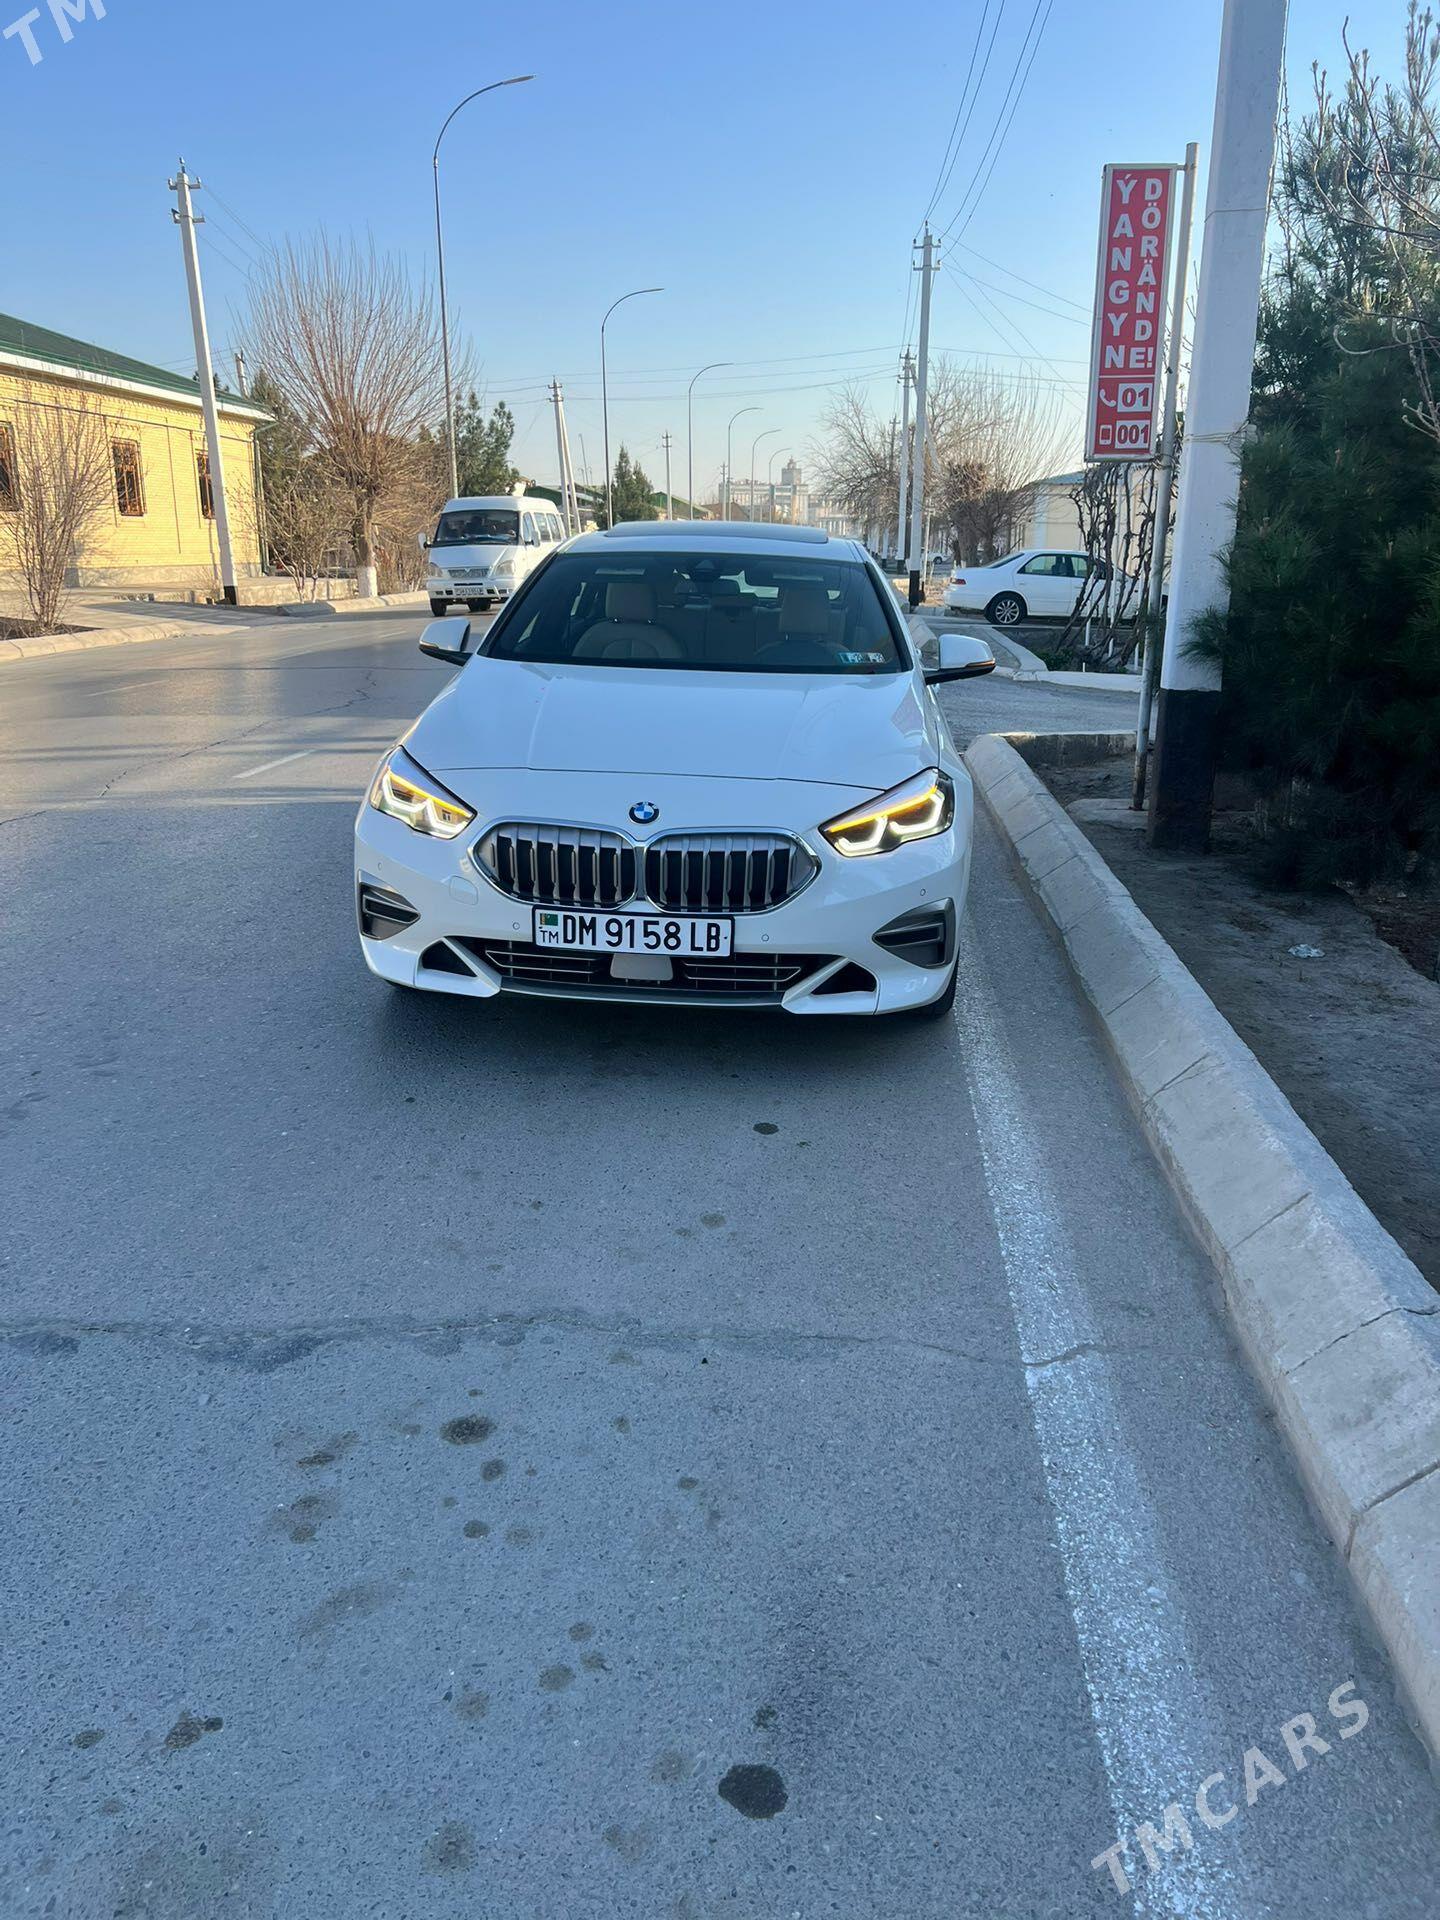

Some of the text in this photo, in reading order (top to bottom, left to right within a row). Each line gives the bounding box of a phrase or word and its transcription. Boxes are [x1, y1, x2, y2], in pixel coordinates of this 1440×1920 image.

[1104, 173, 1137, 369] ÝANGYN
[1129, 178, 1163, 368] DÖRÄNDE!
[1121, 387, 1149, 408] 01
[1116, 424, 1149, 445] 001
[541, 915, 721, 952] TM DM 9158 LB
